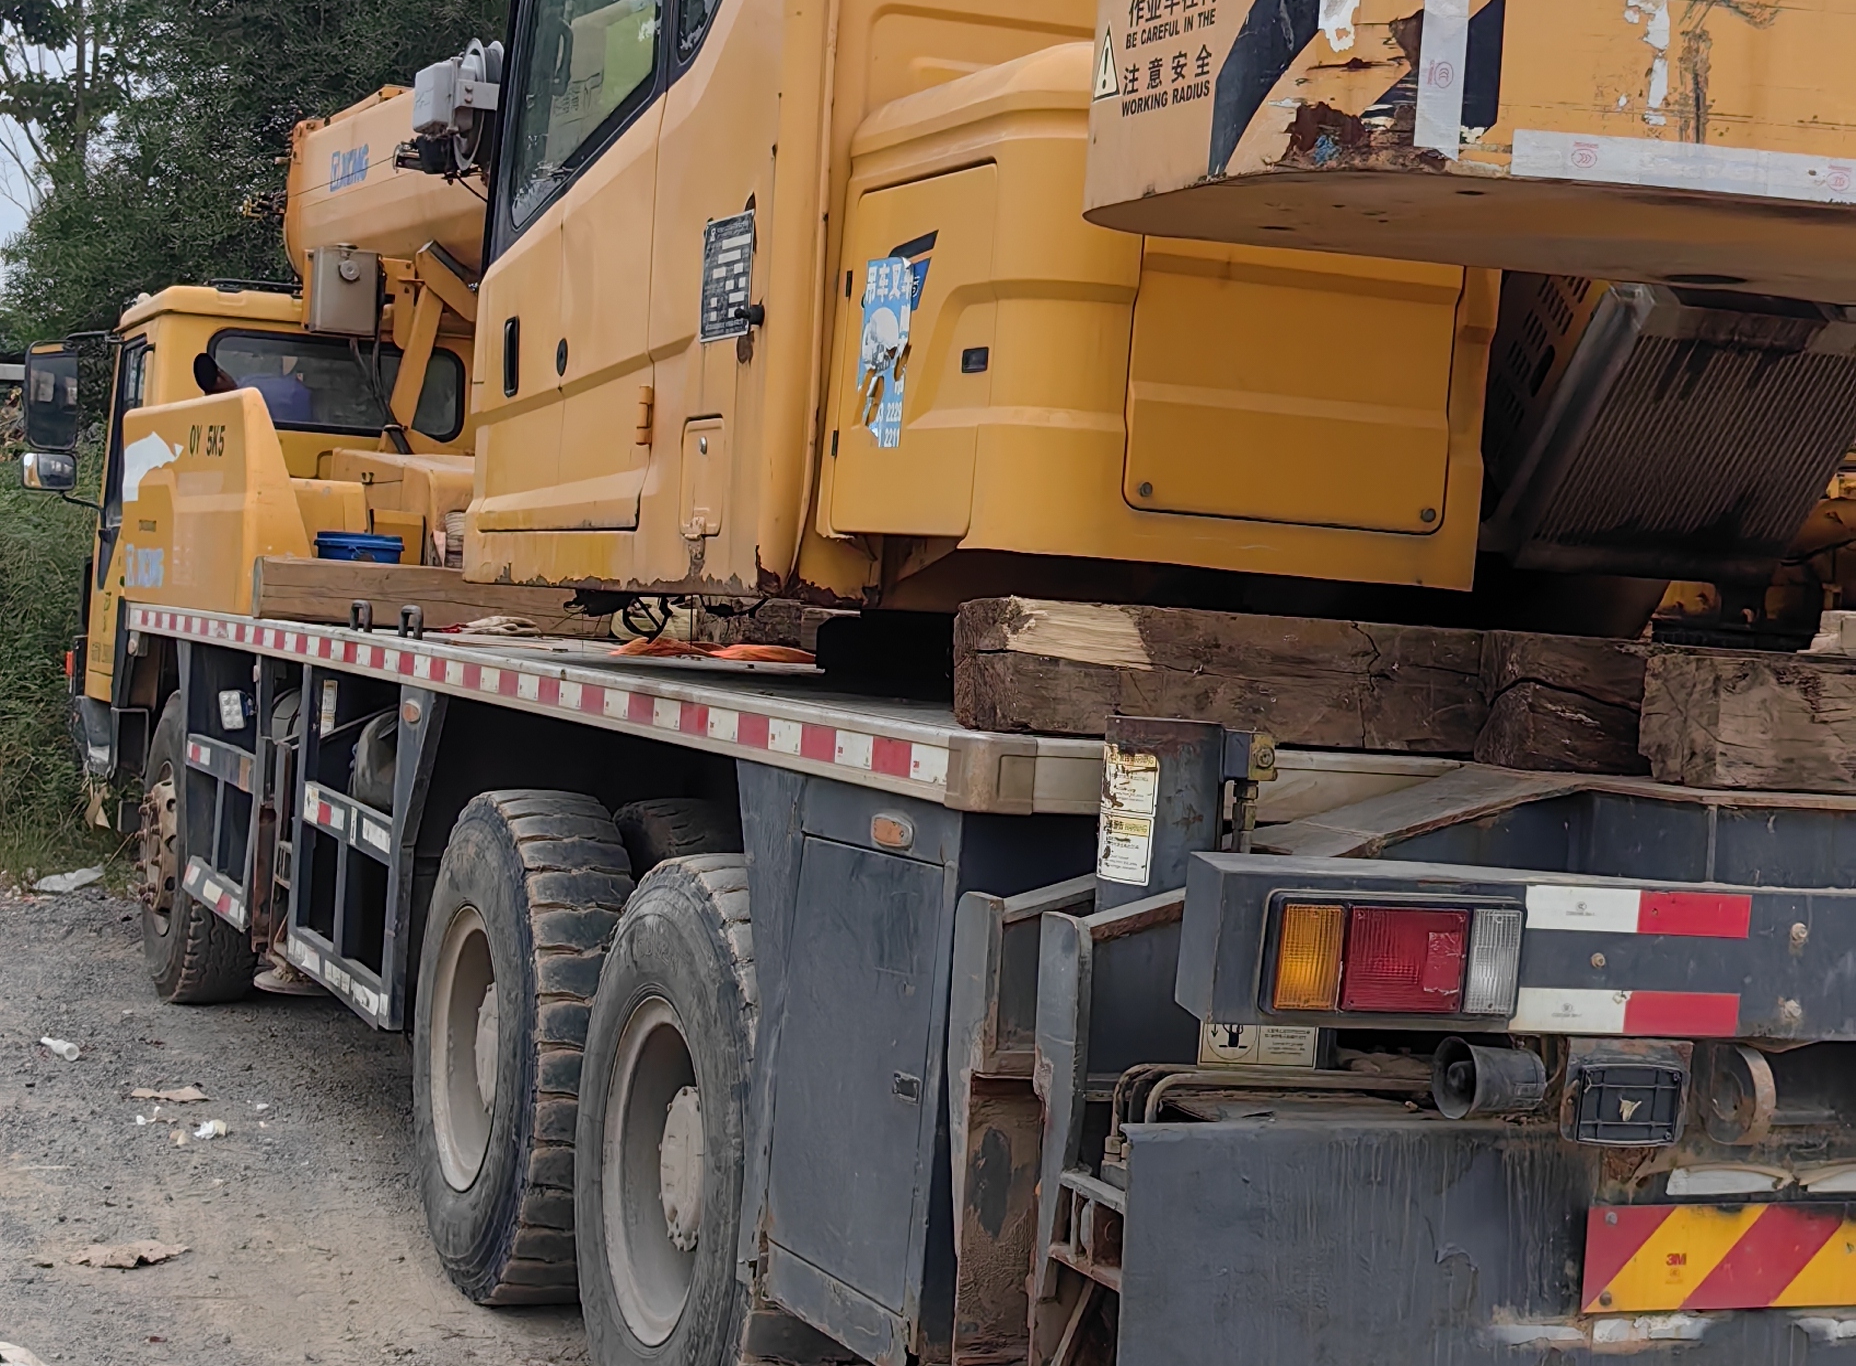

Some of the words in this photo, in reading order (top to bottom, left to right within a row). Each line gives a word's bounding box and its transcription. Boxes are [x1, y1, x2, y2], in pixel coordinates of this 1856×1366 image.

[1125, 32, 1138, 50] BE
[1140, 19, 1180, 45] CAREFUL
[1183, 14, 1194, 33] IN
[1197, 8, 1216, 29] THE
[1122, 43, 1213, 96] 注意安全
[1121, 90, 1169, 117] WORKING
[1172, 79, 1210, 105] RADIUS
[1666, 1253, 1687, 1266] 3M
